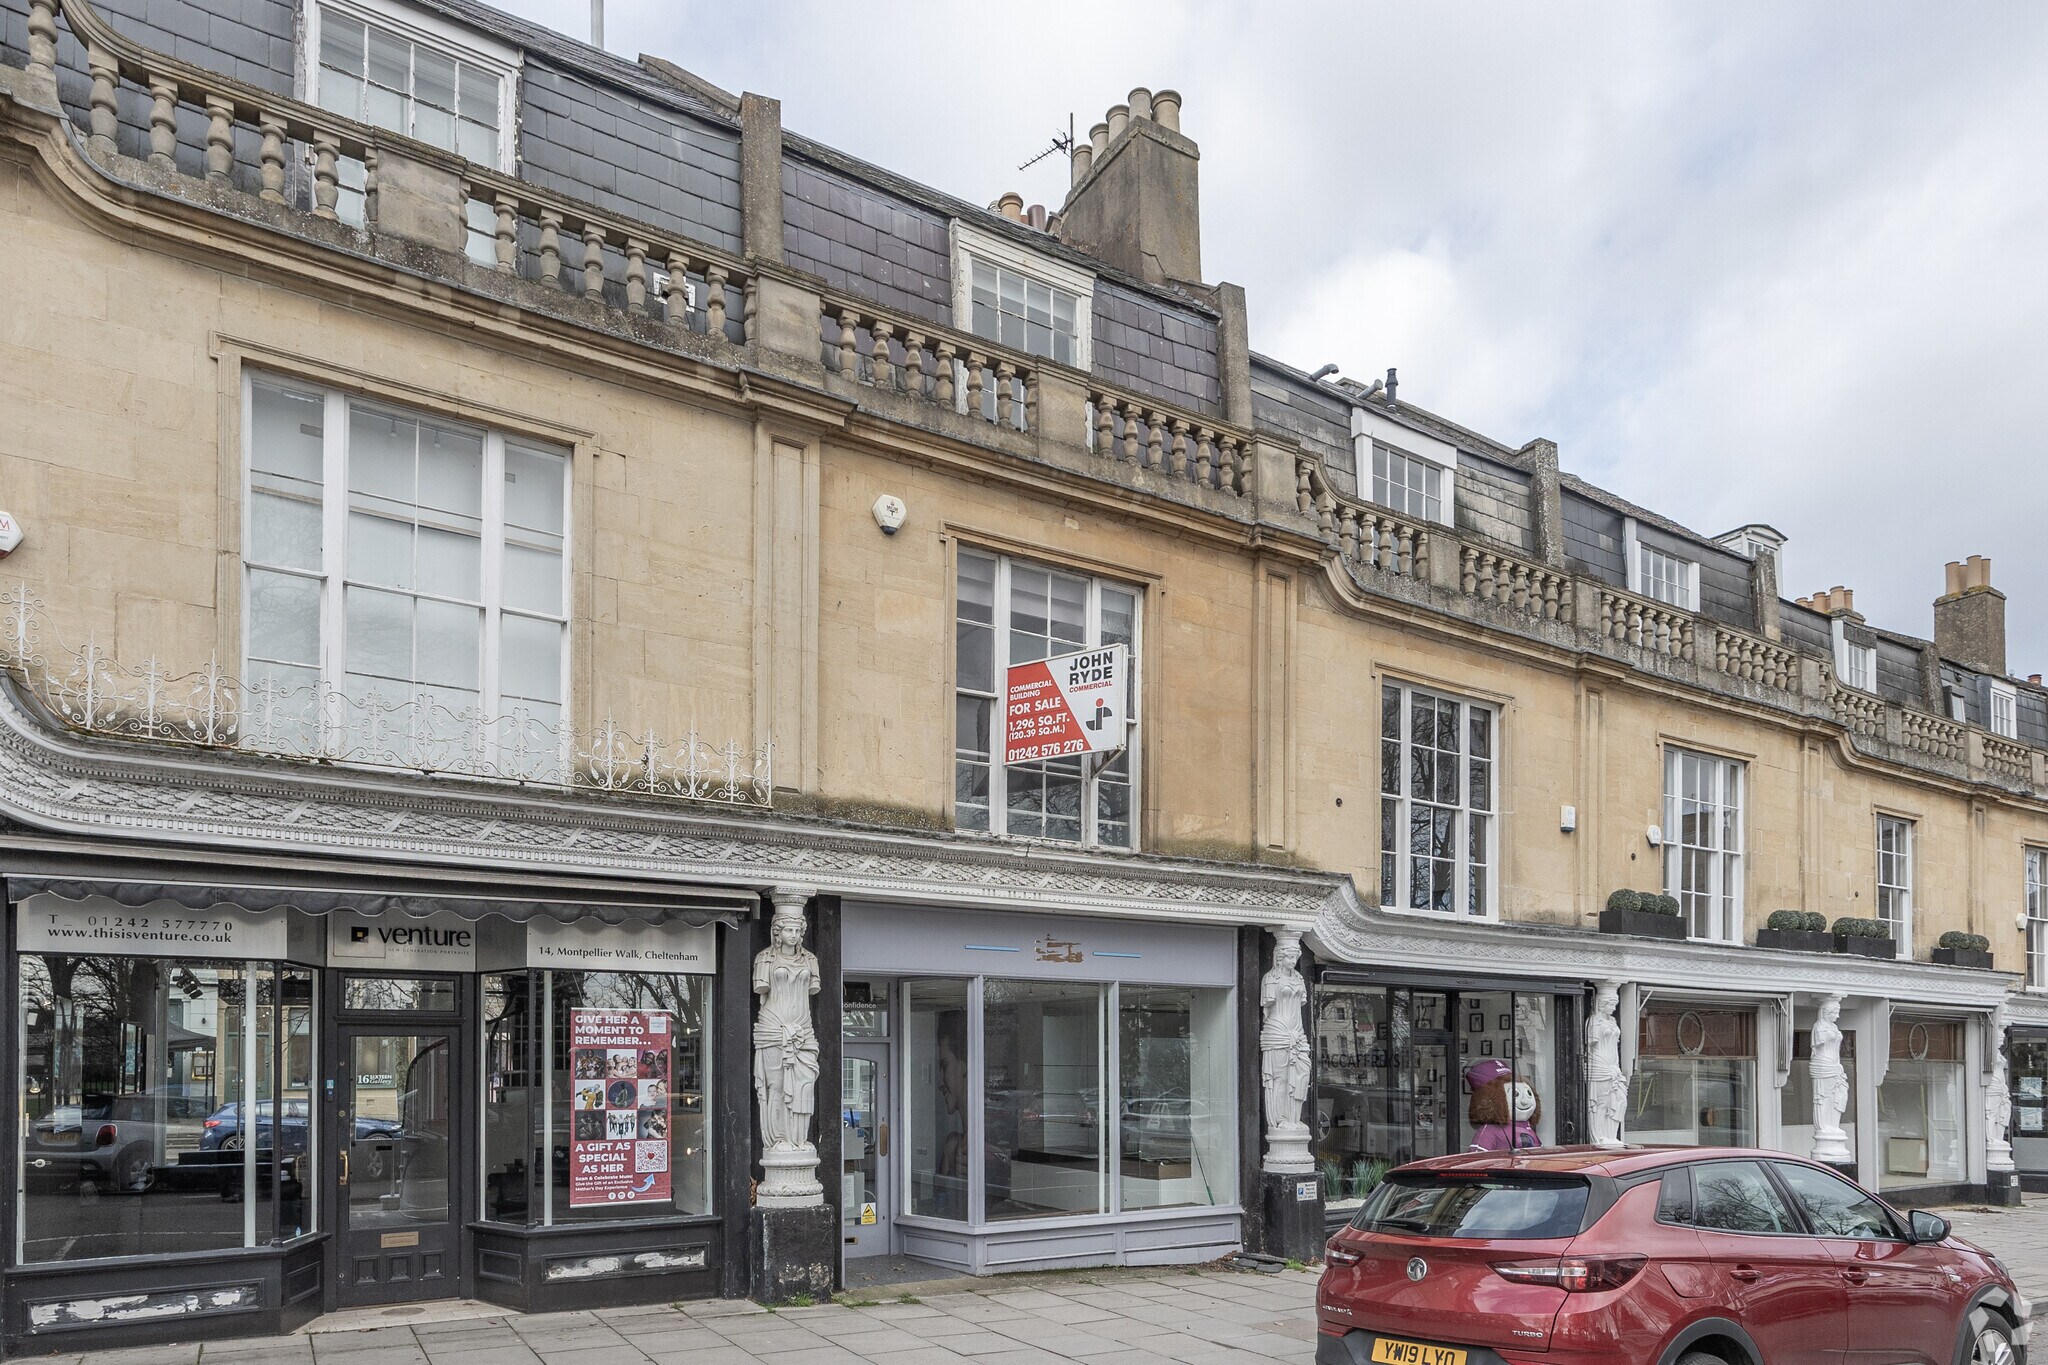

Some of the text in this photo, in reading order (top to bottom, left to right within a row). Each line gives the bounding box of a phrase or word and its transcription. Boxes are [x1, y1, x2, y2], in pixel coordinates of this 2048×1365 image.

[1070, 651, 1112, 671] JOHN
[1069, 666, 1112, 685] RYDE
[1010, 680, 1052, 693] COMMERCIAL
[1069, 681, 1112, 693] COMMERCIAL
[1009, 690, 1040, 700] BUILDING
[1009, 697, 1060, 716] FOR SALE
[1009, 713, 1070, 732] 1,296 SQ.FT.
[1008, 724, 1065, 742] (120.39 SQ.M.)
[1008, 739, 1084, 761] 01242 576 276
[88, 916, 149, 928] 01242
[162, 918, 233, 932] 577770
[48, 927, 232, 943] www.thisisventure.co.uk
[377, 926, 471, 947] venture
[539, 946, 698, 961] 14, Montpellier Walk, Cheltenham
[575, 1015, 639, 1024] GIVE HER A
[575, 1025, 644, 1035] MOMENT TO
[575, 1036, 651, 1045] REMEMBER...
[357, 1074, 369, 1084] 16
[575, 1142, 631, 1152] A GIFT AS
[579, 1153, 627, 1163] SPECIAL
[582, 1164, 624, 1173] AS HER
[1512, 1330, 1543, 1338] TURBO
[1385, 1341, 1418, 1363] YW19
